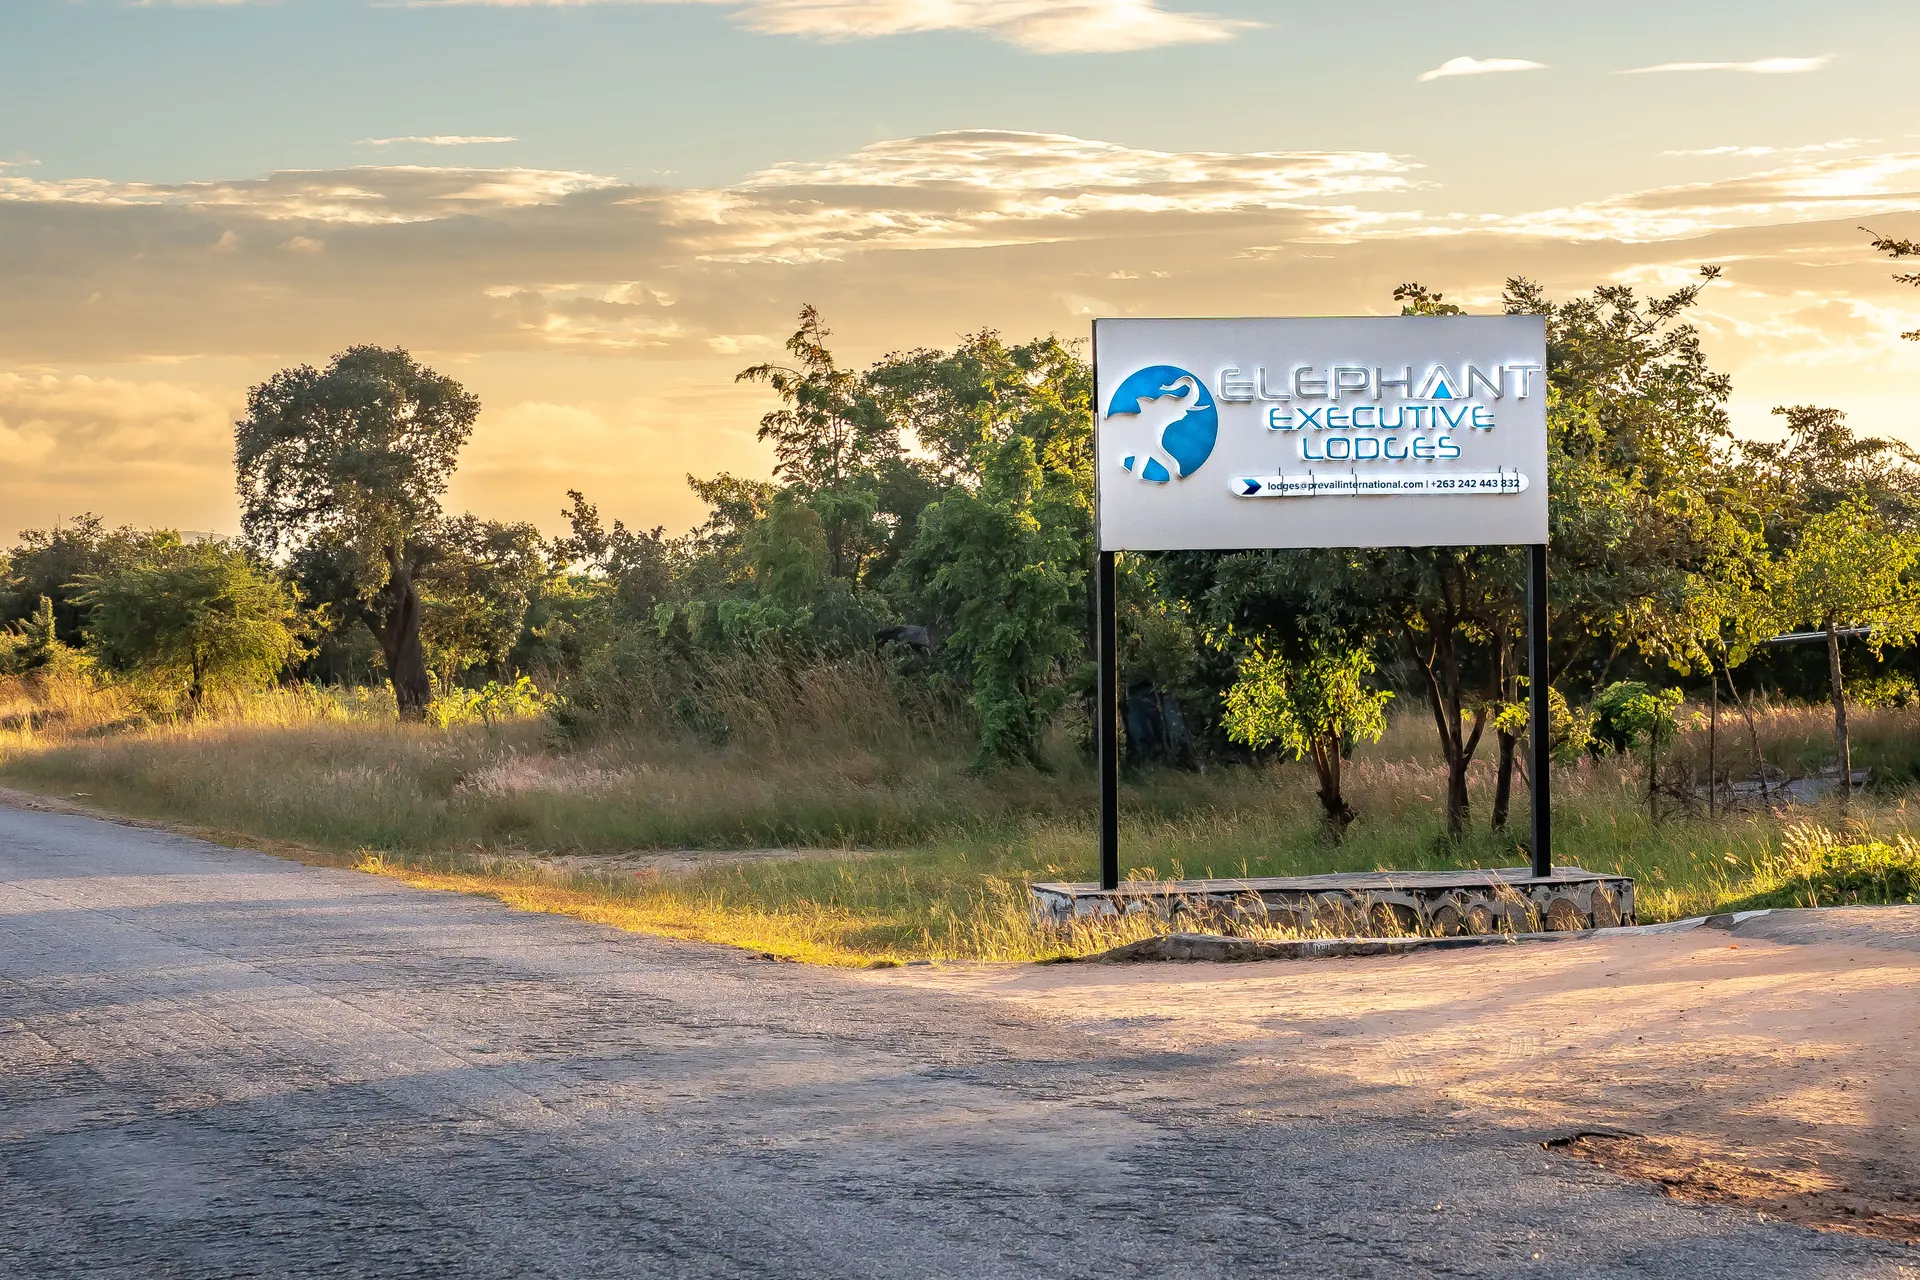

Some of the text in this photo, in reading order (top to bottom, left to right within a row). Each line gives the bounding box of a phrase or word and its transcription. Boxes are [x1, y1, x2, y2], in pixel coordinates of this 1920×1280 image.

[1218, 365, 1542, 401] ELEPHANT
[1268, 405, 1496, 430] EXECUTIVE
[1302, 436, 1462, 461] LODGES
[1267, 480, 1424, 491] lodges@prevailinternational.com
[1430, 479, 1456, 488] +263
[1457, 479, 1477, 488] 242
[1479, 479, 1498, 488] 443
